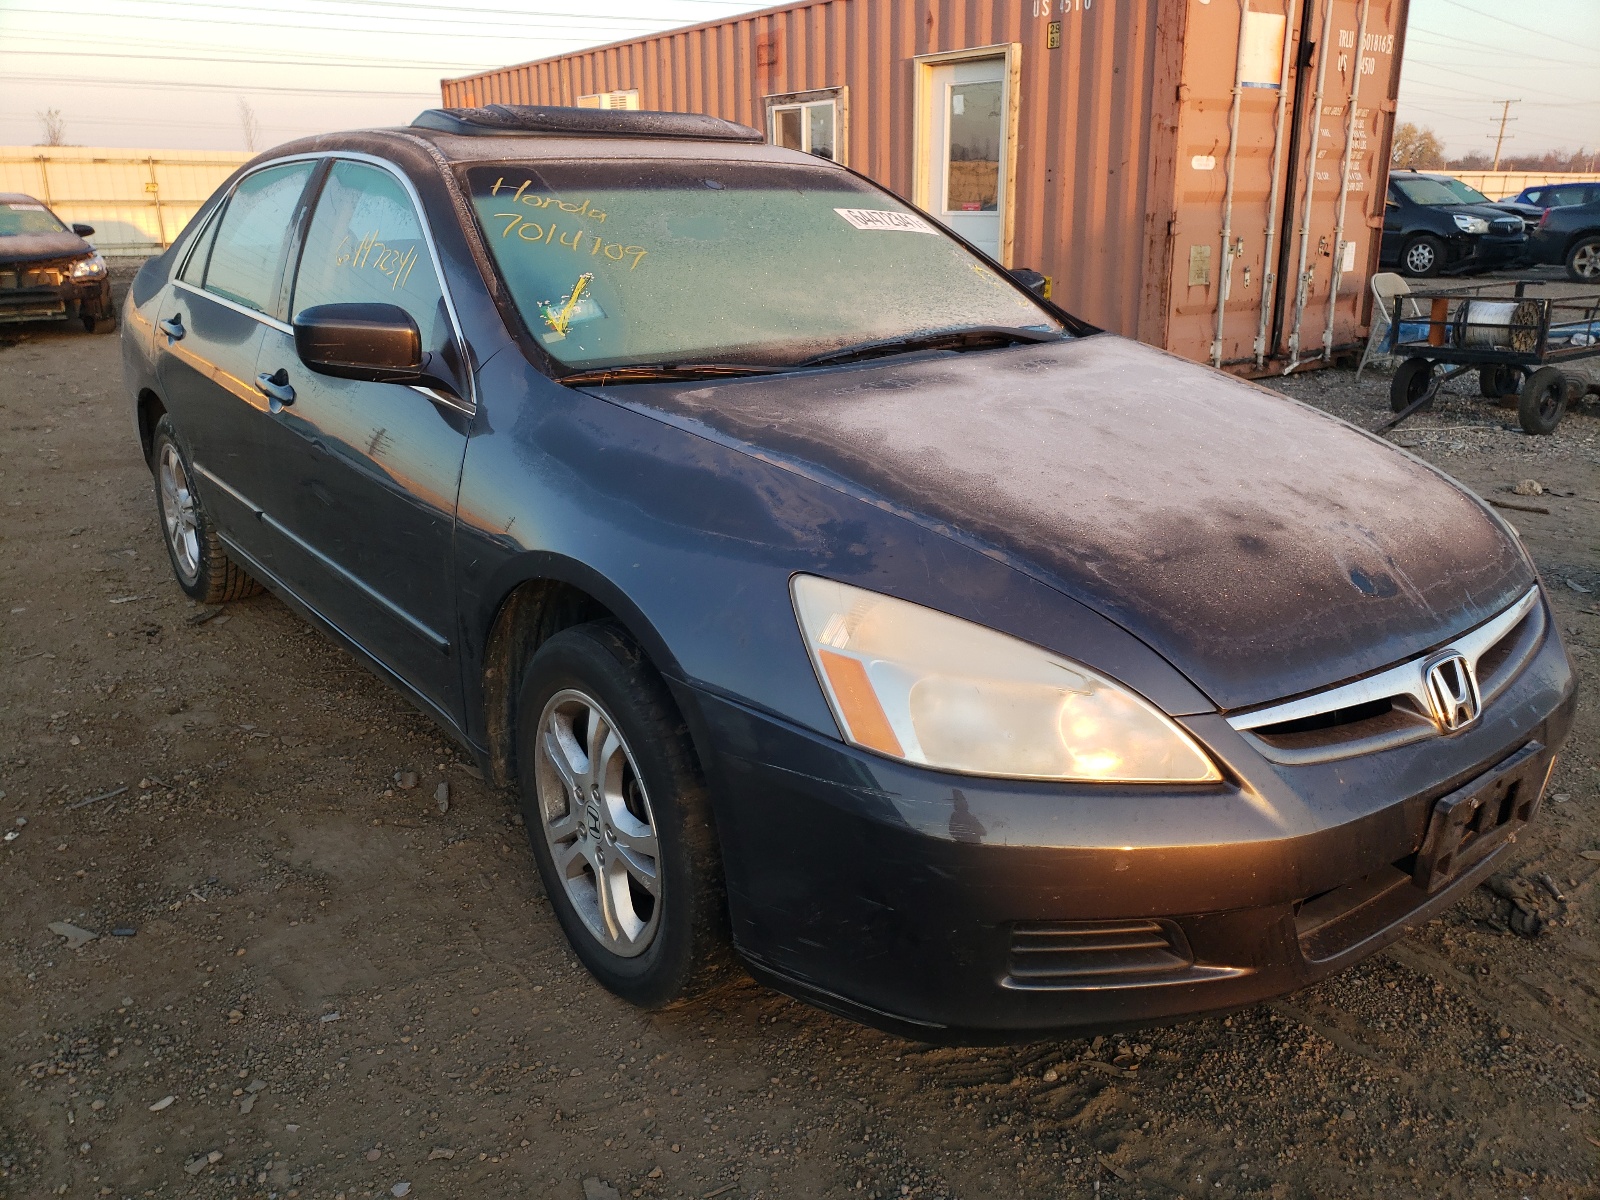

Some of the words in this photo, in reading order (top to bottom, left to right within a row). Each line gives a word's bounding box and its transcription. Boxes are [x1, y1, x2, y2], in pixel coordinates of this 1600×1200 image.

[1339, 30, 1354, 48] TRLU
[1337, 54, 1348, 72] US
[490, 177, 607, 223] Honda
[494, 213, 648, 271] 7014109
